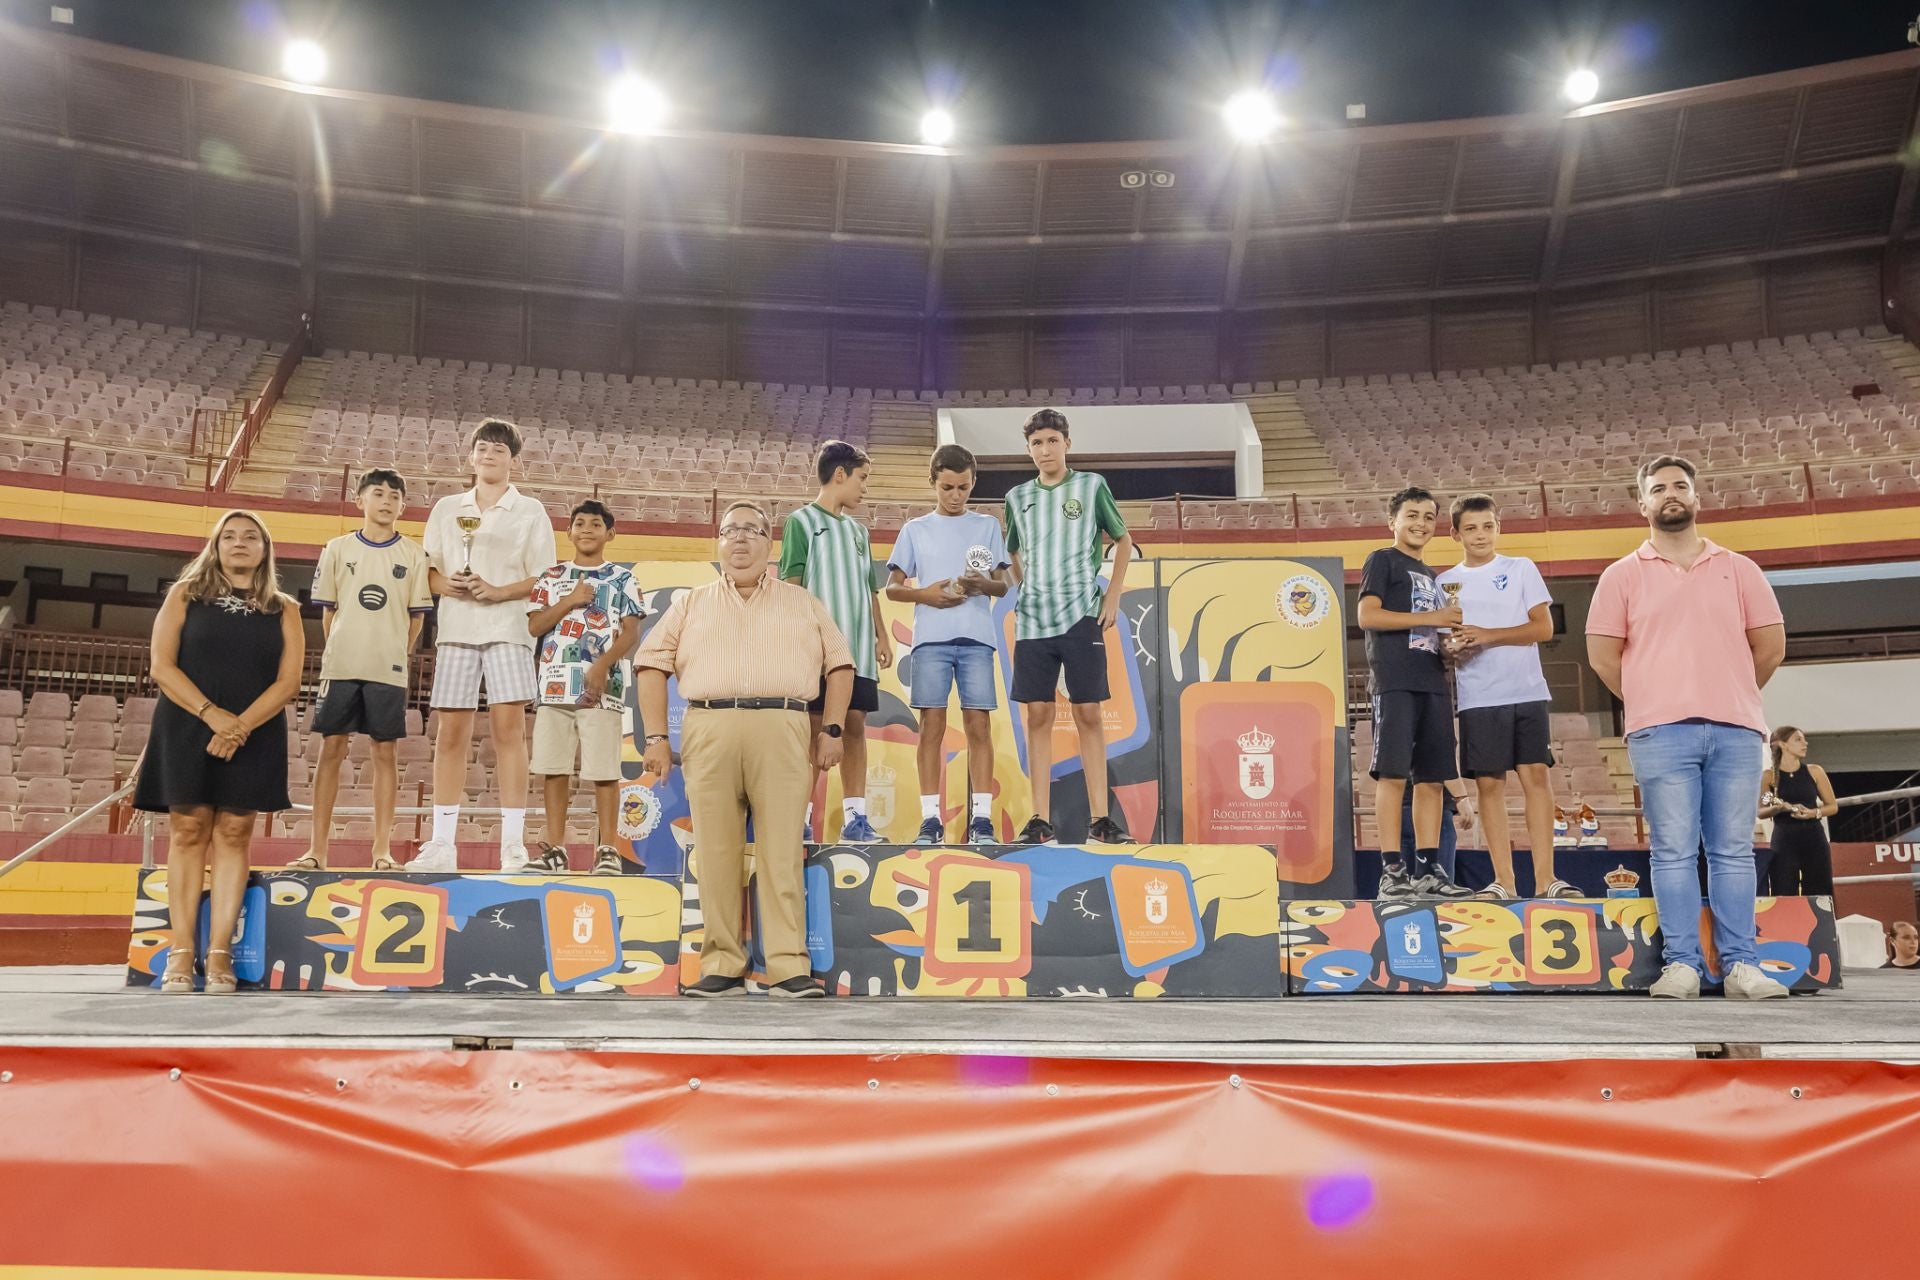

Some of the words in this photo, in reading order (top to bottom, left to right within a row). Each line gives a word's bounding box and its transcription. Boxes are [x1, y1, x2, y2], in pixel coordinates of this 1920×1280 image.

[1213, 809, 1261, 820] ROQUETAS
[1265, 811, 1276, 819] DE
[1280, 809, 1303, 819] MAR
[375, 902, 426, 964] 2
[953, 881, 1001, 952] 1
[1541, 919, 1581, 970] 3
